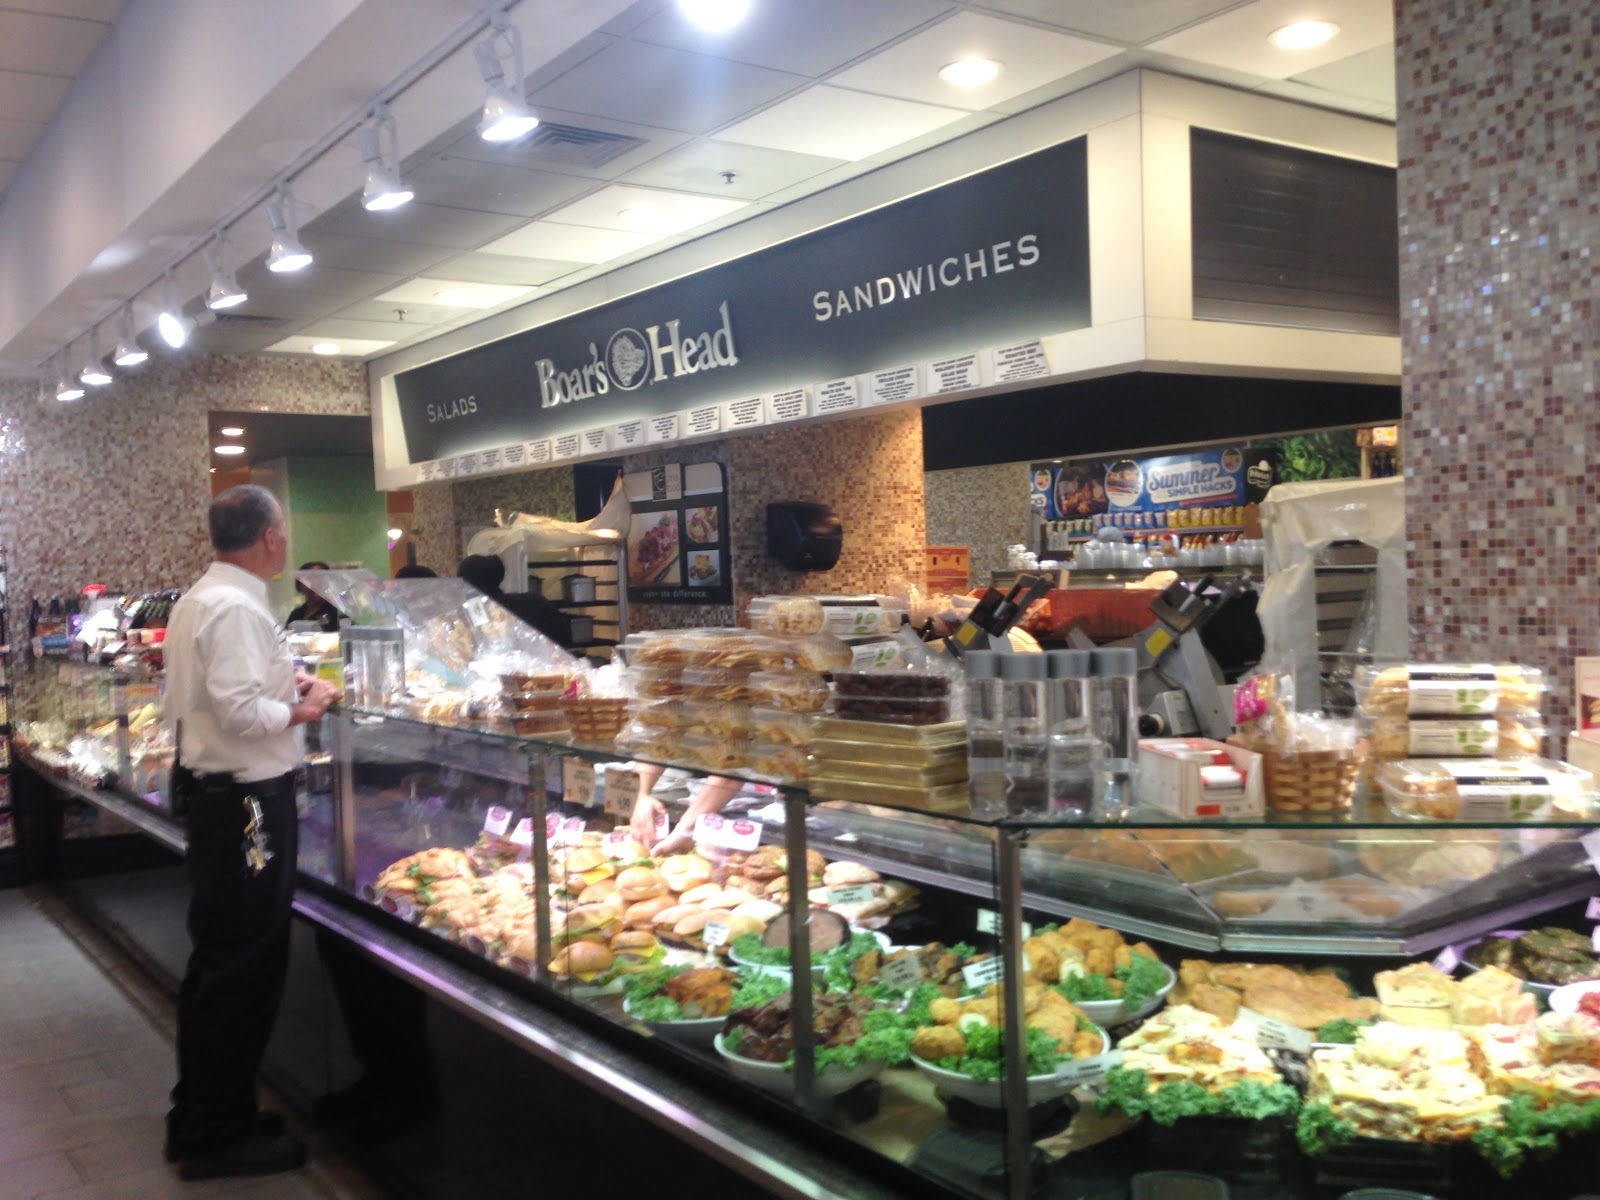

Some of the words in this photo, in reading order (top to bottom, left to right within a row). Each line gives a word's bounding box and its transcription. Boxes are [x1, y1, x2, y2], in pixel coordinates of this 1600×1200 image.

[813, 234, 1040, 322] SANDWICHES
[535, 341, 609, 409] Boar's
[646, 300, 739, 382] Head
[427, 396, 477, 423] SALADS
[1149, 467, 1217, 490] Summer
[1168, 484, 1199, 497] SIMPLE
[1201, 480, 1233, 492] HACKS
